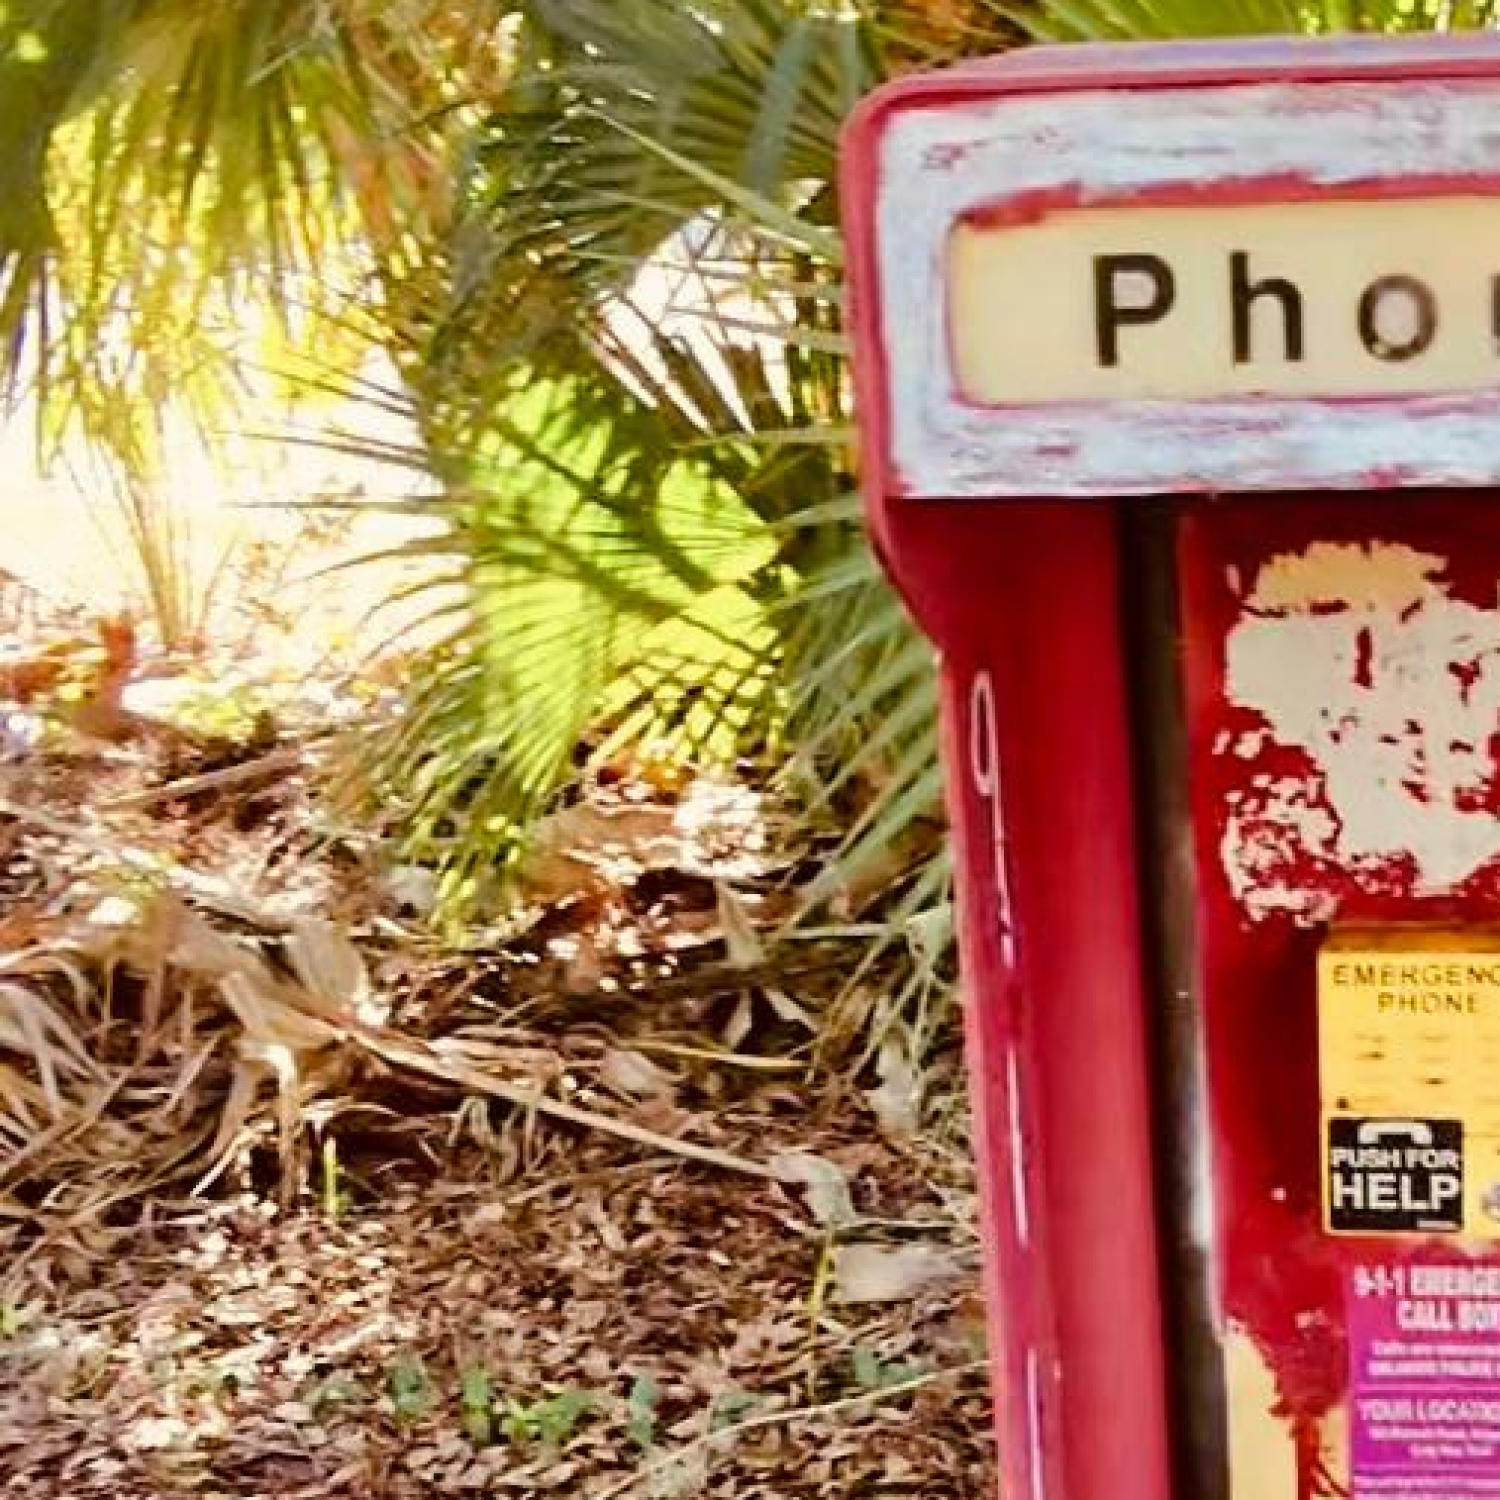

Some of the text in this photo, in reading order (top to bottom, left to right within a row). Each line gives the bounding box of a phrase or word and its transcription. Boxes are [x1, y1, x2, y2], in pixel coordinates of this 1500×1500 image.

[1377, 990, 1479, 1013] PHONE
[1330, 1148, 1461, 1170] PUSH FOR
[1332, 1172, 1461, 1211] HELP
